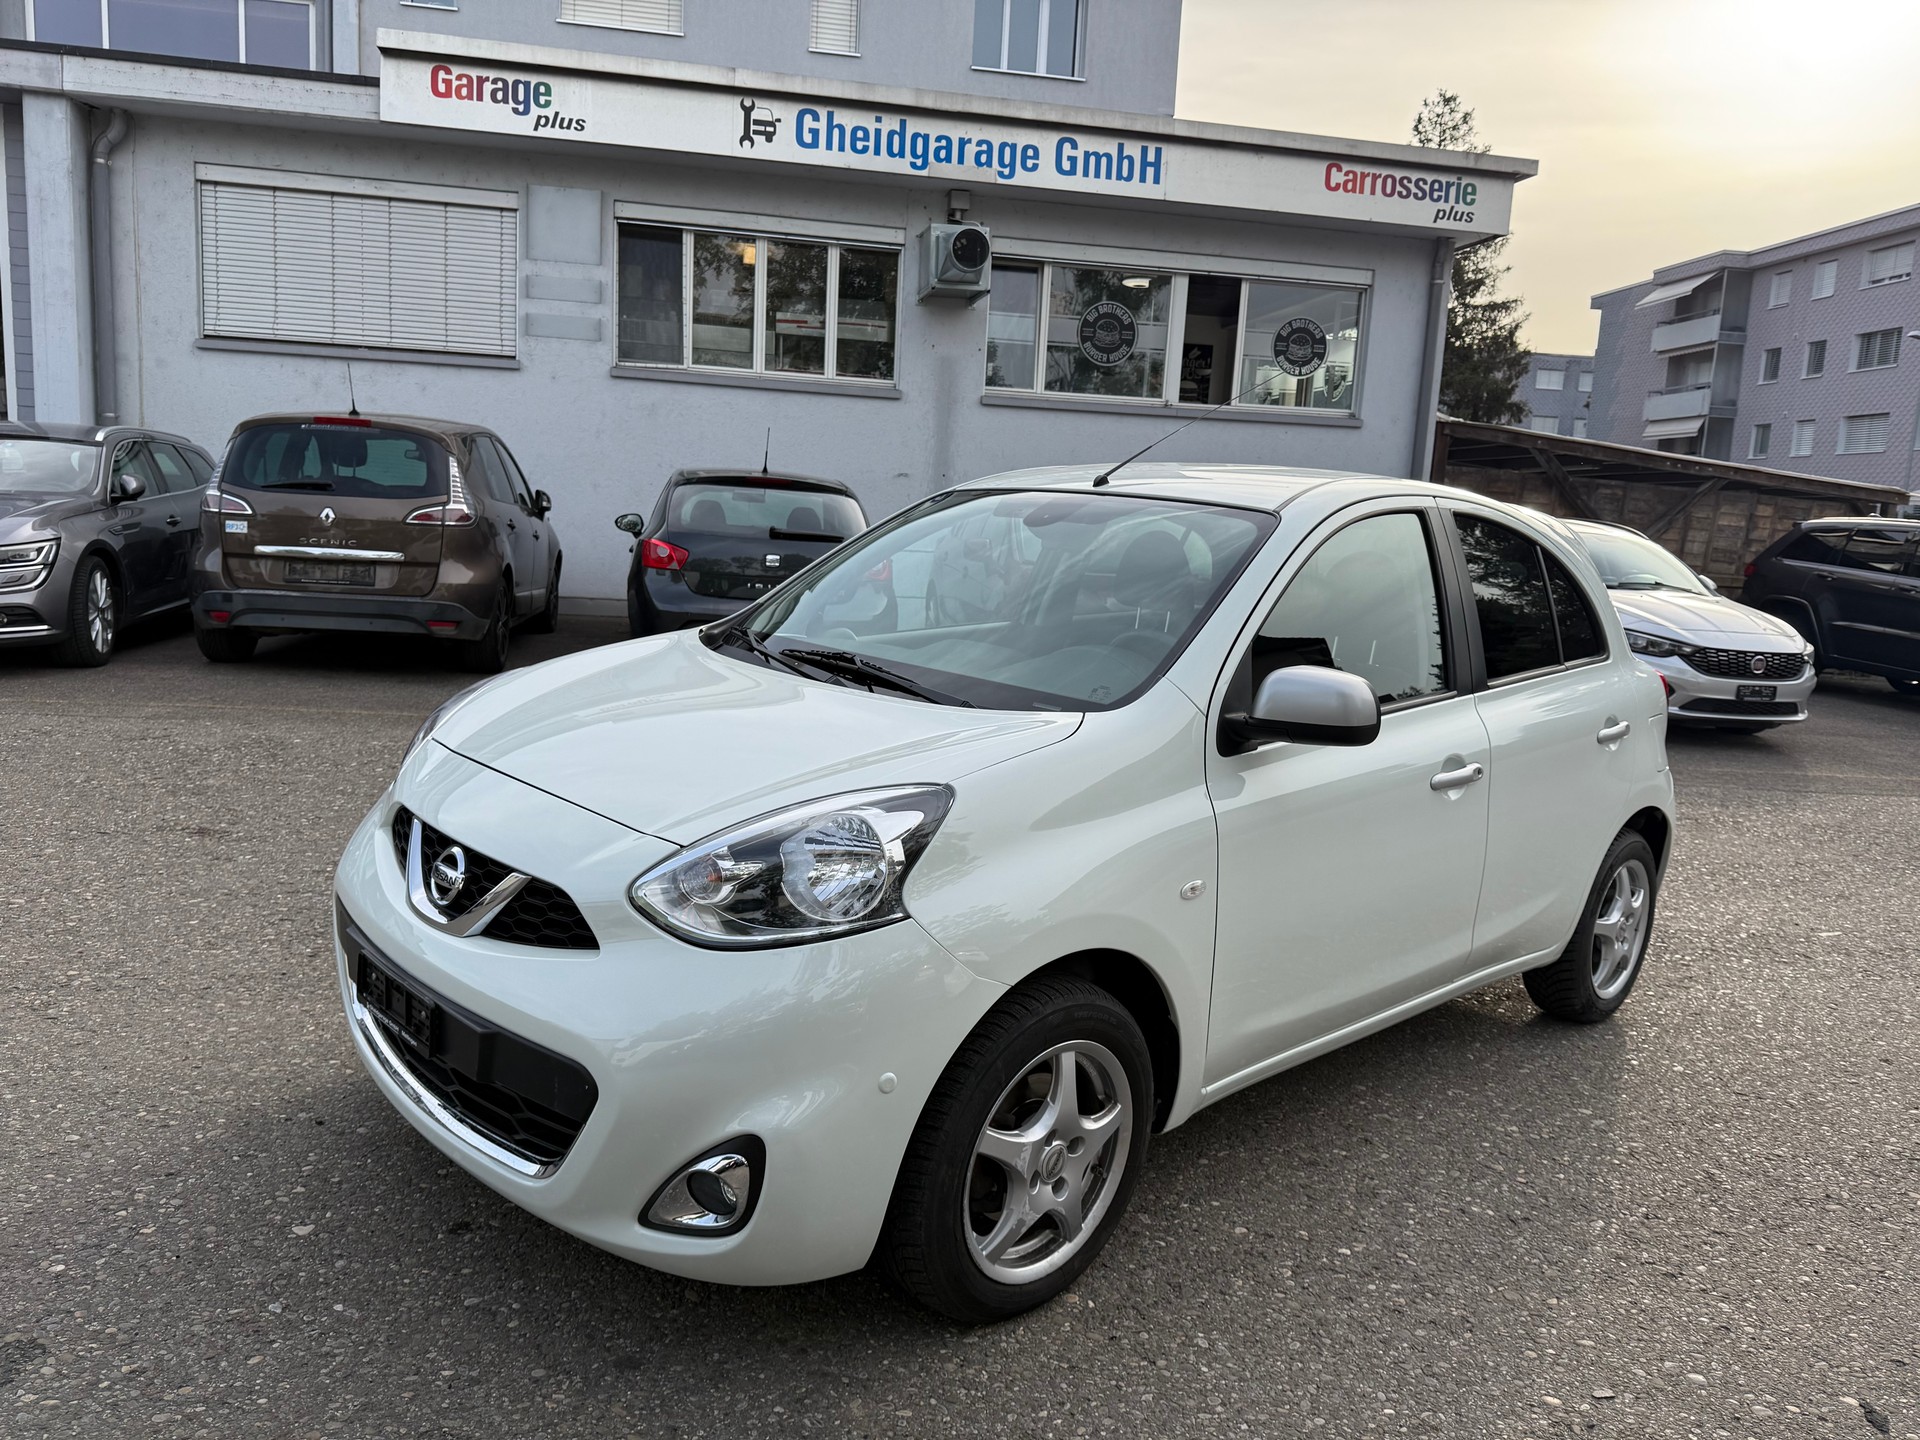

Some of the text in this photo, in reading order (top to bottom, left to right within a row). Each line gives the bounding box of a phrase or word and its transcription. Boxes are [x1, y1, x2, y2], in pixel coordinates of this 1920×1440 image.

[430, 64, 552, 116] Garage
[533, 111, 587, 132] plus
[795, 107, 1163, 185] Gheidgarage GmbH
[1324, 162, 1477, 206] Carrosserie
[1433, 206, 1475, 223] plus
[1086, 304, 1131, 325] BIG BROTHERS
[1280, 319, 1323, 339] BIG BROTHERS
[1083, 341, 1131, 362] BURGER HOUSE
[1300, 357, 1321, 375] HOUSE
